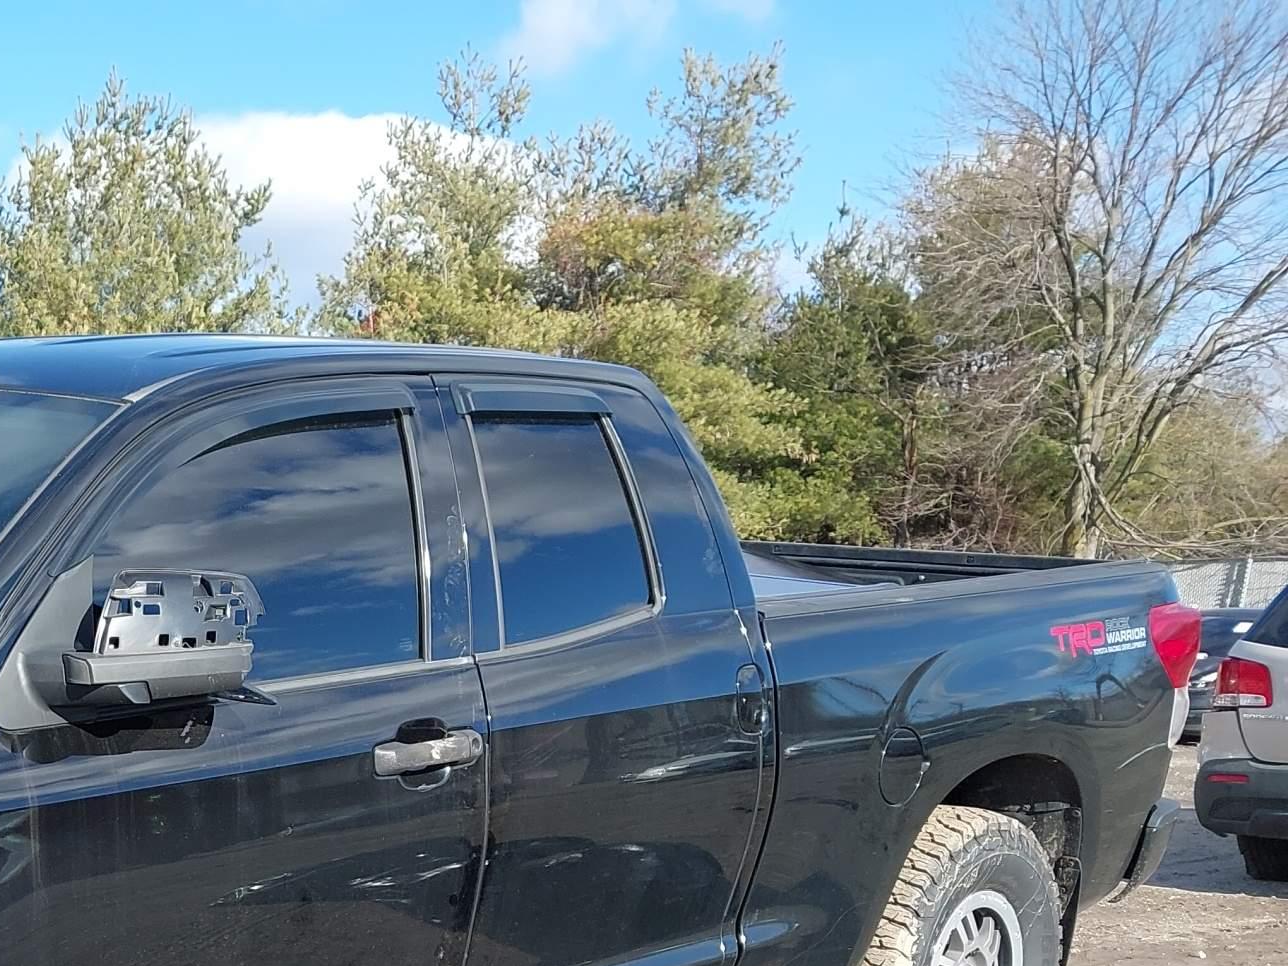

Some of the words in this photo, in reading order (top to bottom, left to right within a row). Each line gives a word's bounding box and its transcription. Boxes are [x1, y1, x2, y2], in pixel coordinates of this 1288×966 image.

[1105, 616, 1130, 632] ROCK
[1049, 620, 1106, 658] TRD
[1106, 627, 1146, 644] WARRIOR
